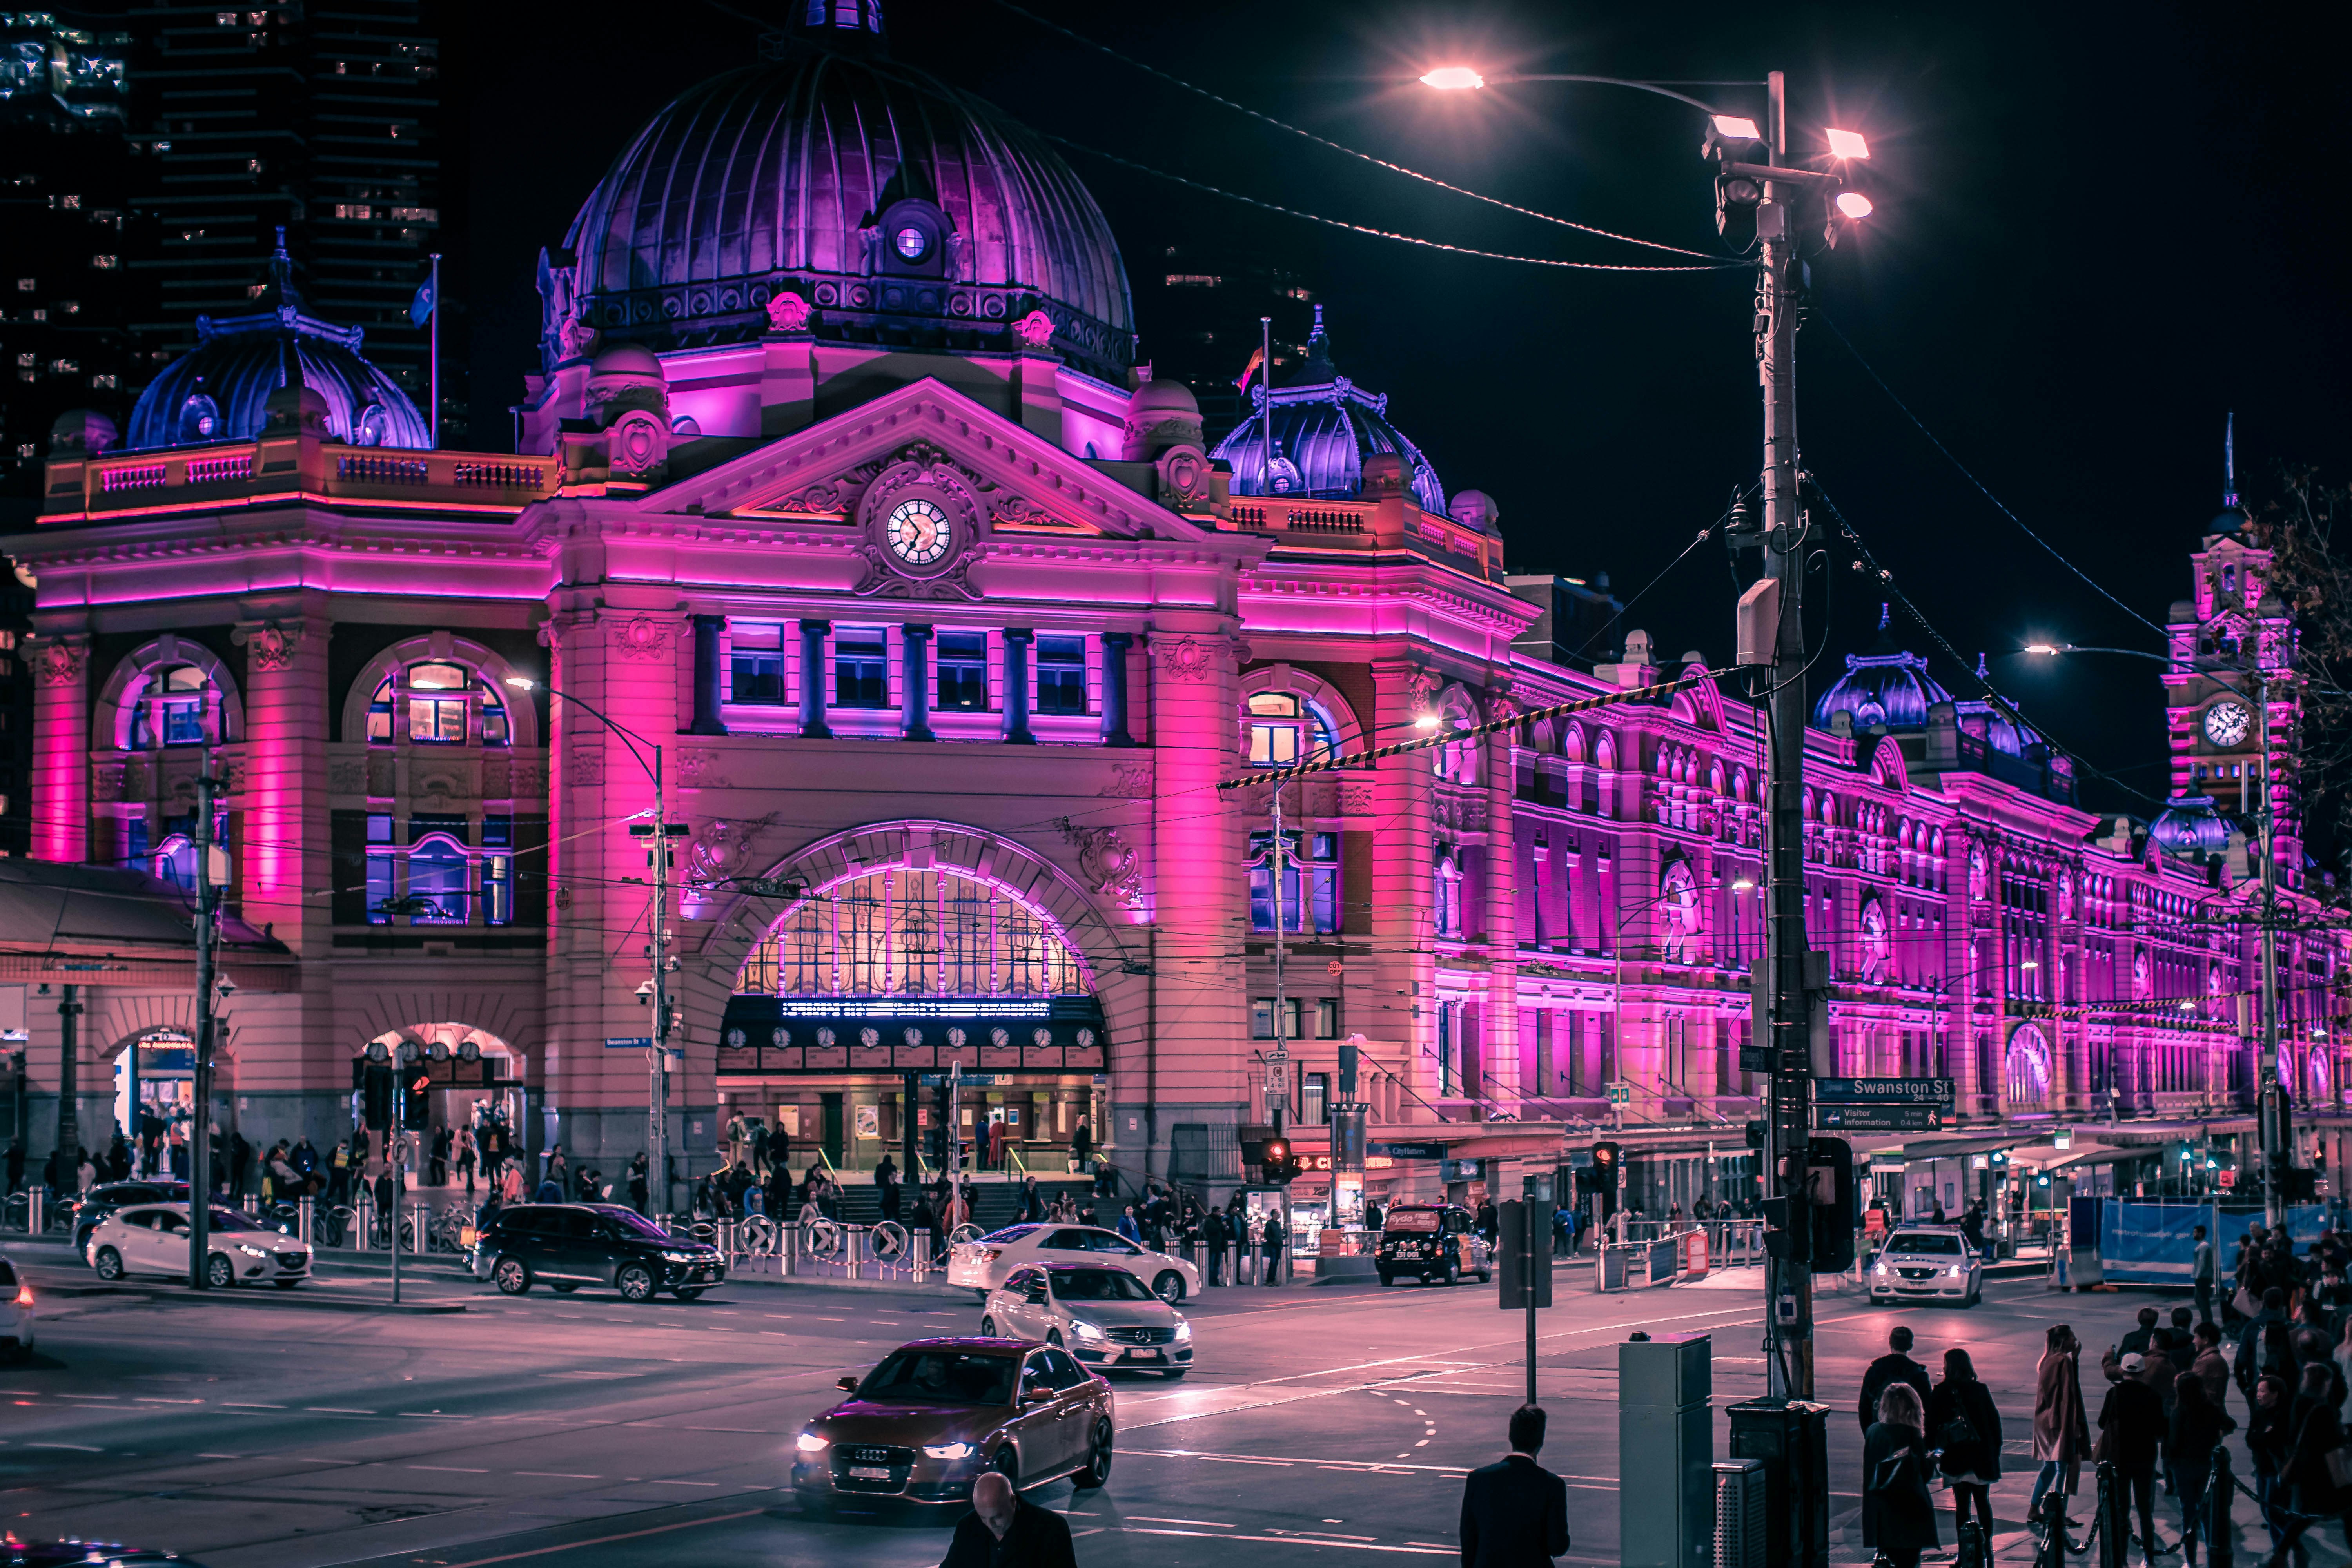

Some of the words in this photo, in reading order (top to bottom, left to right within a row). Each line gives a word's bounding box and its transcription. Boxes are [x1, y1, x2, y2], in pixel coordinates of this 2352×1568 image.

[1854, 1080, 1929, 1094] Swanston
[1933, 1080, 1949, 1094] St
[1388, 1215, 1413, 1225] Rydo
